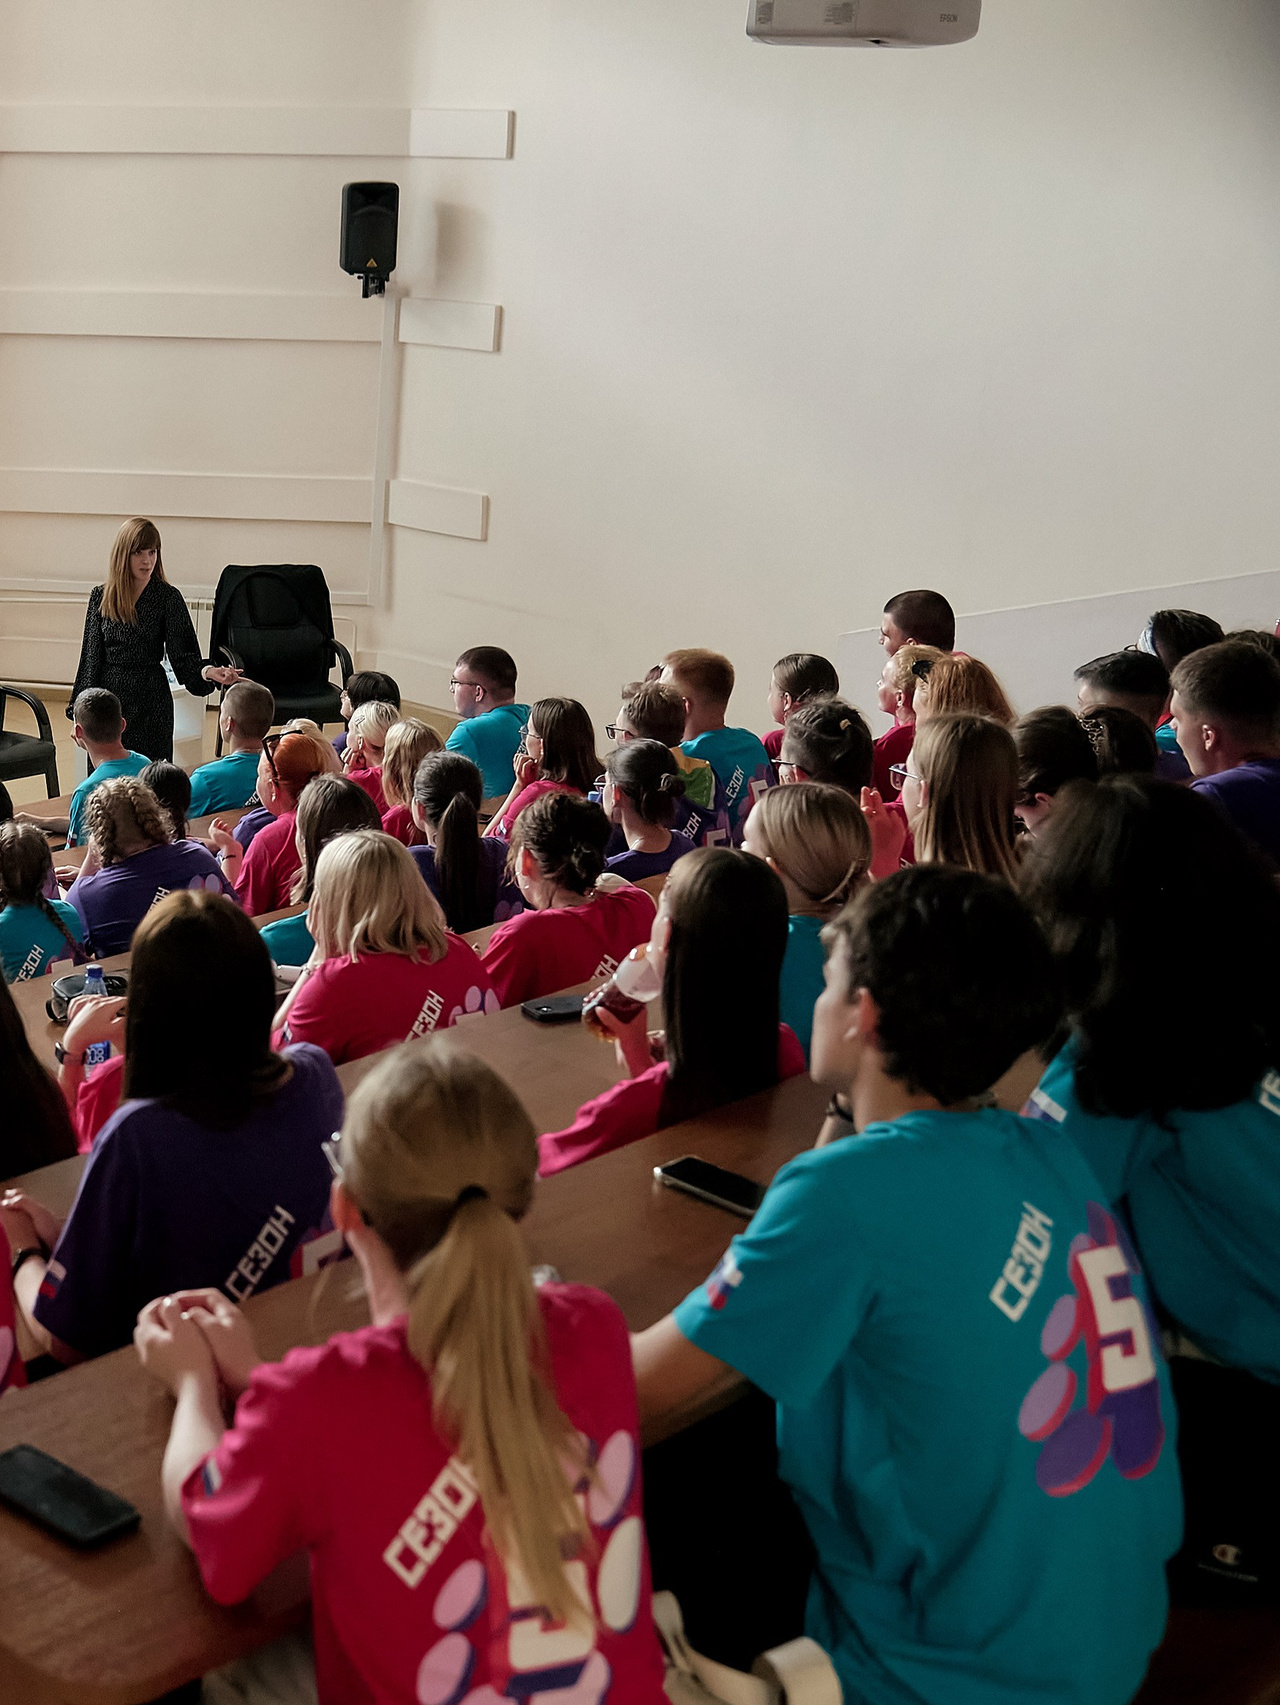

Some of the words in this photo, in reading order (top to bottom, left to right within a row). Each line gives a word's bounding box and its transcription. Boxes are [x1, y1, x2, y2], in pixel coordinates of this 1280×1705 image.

[223, 1204, 296, 1304] СЕЗОН
[989, 1202, 1055, 1323] СЕЗОН
[1077, 1245, 1158, 1393] 5
